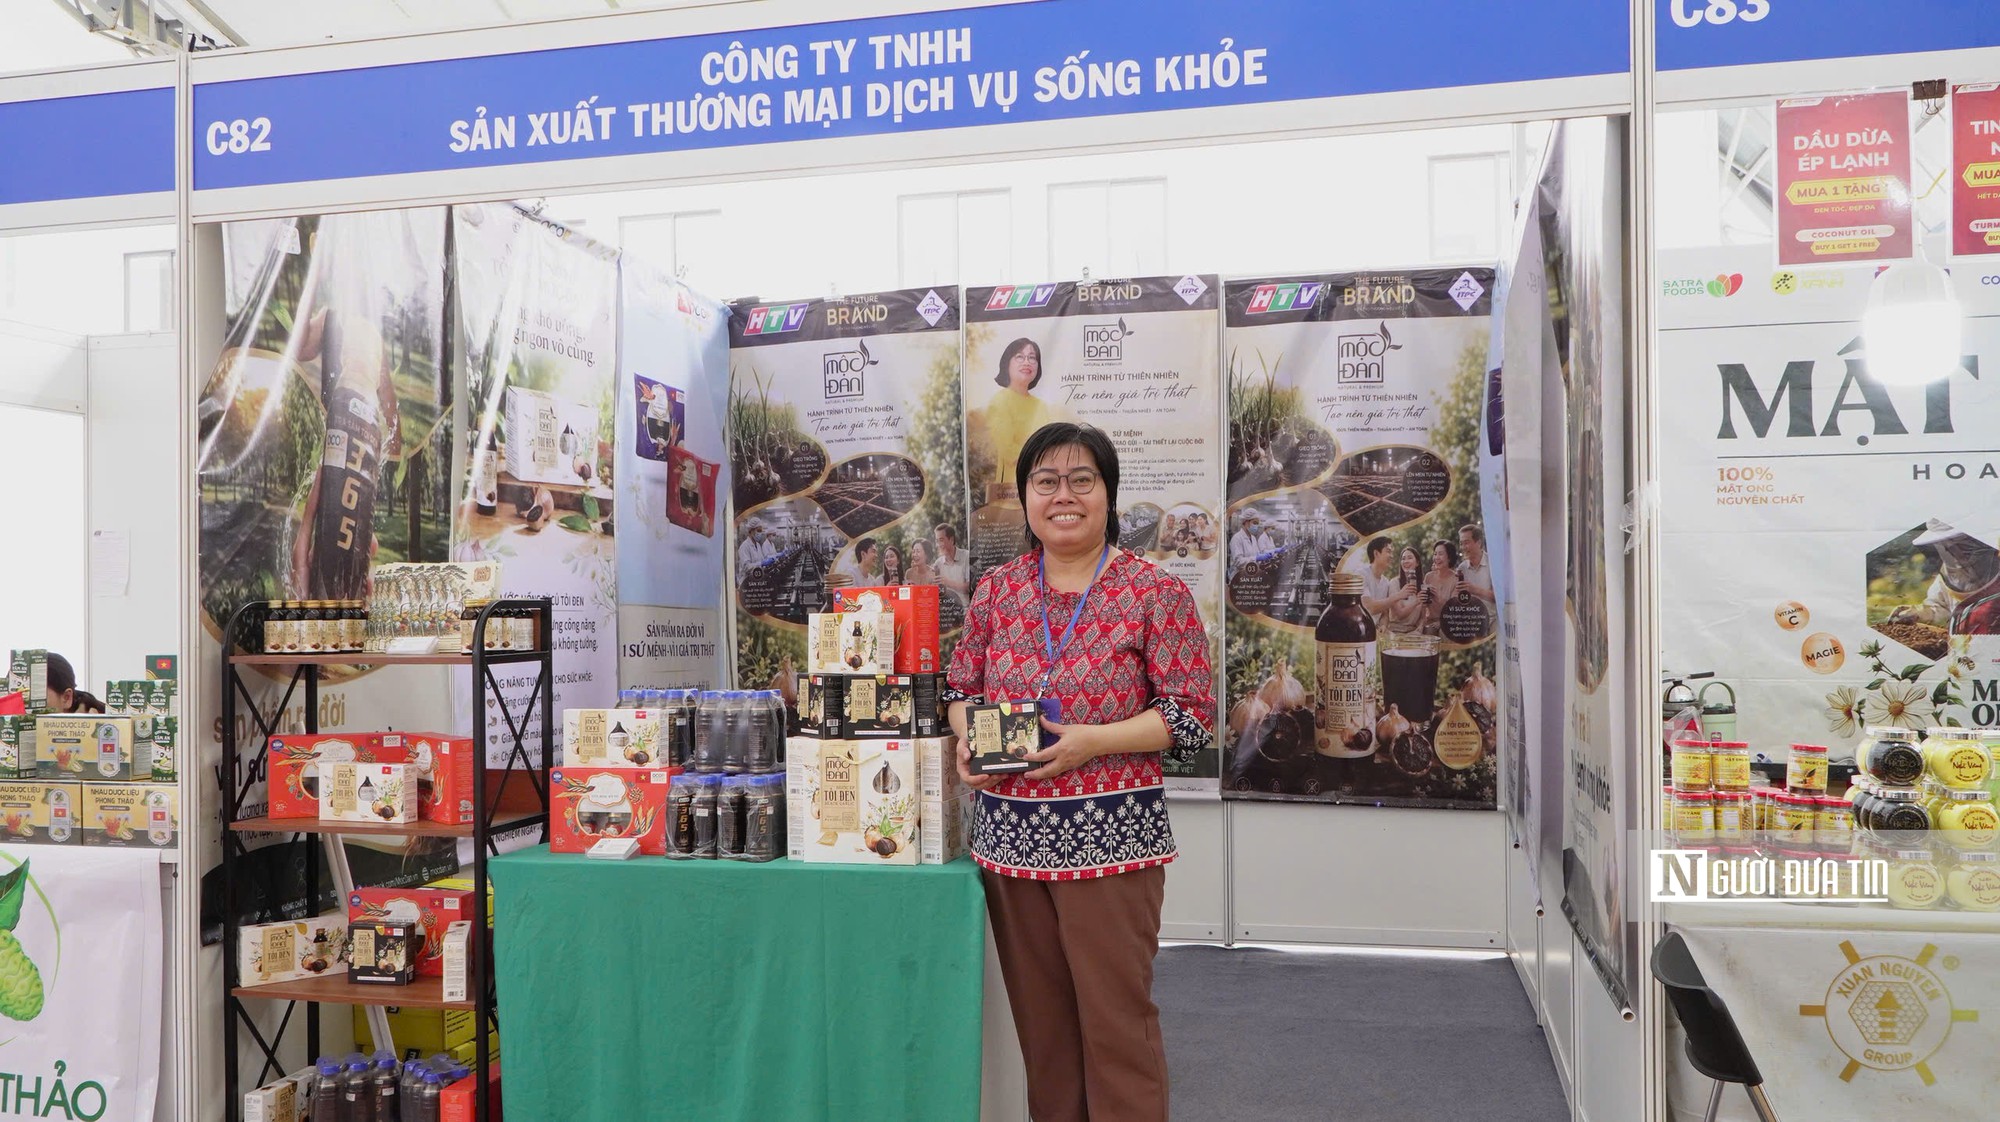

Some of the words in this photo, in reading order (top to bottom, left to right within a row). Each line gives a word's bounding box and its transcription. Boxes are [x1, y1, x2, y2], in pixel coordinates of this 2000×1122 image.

[700, 41, 799, 87] CÔNG
[808, 39, 858, 77] TY
[869, 27, 972, 71] TNHH
[449, 106, 516, 153] SẢN
[526, 96, 616, 146] XUẤT
[626, 92, 771, 138] THƯƠNG
[784, 86, 852, 128] MẠI
[866, 75, 954, 122] DỊCH
[968, 71, 1017, 113] VỤ
[1034, 51, 1141, 103] SỐNG
[1155, 37, 1268, 92] KHỎE
[206, 117, 271, 156] C82
[1794, 129, 1840, 151] DẦU
[1846, 128, 1893, 147] DỪA
[1798, 154, 1825, 172] ÉP
[1831, 152, 1889, 173] LẠNH
[1797, 188, 1828, 198] MUA
[1832, 187, 1839, 196] 1
[1844, 183, 1880, 197] TẶNG
[1811, 230, 1857, 238] COCONUT
[1252, 283, 1320, 308] HTV
[1372, 275, 1405, 284] FUTURE
[1663, 279, 1703, 289] SATRA
[1663, 286, 1705, 296] FOODS
[992, 284, 1050, 306] HTV
[1078, 285, 1142, 302] BRAND
[1344, 285, 1415, 306] BRAND
[749, 305, 804, 330] HTV
[826, 303, 888, 326] BRAND
[551, 338, 565, 355] vô
[1061, 374, 1085, 382] HÀNH
[1087, 373, 1112, 381] TRÌNH
[1114, 371, 1126, 381] TỪ
[1128, 371, 1151, 380] THIÊN
[1153, 370, 1179, 379] NHIÊN
[1091, 389, 1115, 400] nên
[1114, 390, 1139, 408] giá
[1143, 384, 1160, 400] trị
[1163, 382, 1199, 400] thật
[1373, 393, 1394, 401] THIÊN
[1395, 392, 1418, 401] NHIÊN
[1364, 410, 1384, 426] giá
[1401, 404, 1430, 419] thật
[1112, 429, 1122, 437] SỨ
[1123, 429, 1143, 437] MỆNH
[1717, 467, 1774, 482] 100%
[1746, 484, 1774, 493] ONG
[1717, 495, 1768, 505] NGUYÊN
[1772, 493, 1805, 504] CHẤT
[1777, 606, 1804, 618] VITAMIN
[1788, 615, 1799, 626] C
[564, 618, 580, 633] công
[580, 618, 596, 633] năng
[646, 620, 661, 637] SẢN
[661, 619, 676, 638] PHẨM
[677, 625, 685, 638] RA
[686, 623, 697, 638] ĐỜI
[698, 622, 704, 638] VÌ
[558, 636, 579, 653] không
[623, 644, 627, 657] 1
[629, 641, 646, 657] SỨ
[690, 644, 699, 659] TRỊ
[701, 641, 715, 659] THẬT
[1806, 646, 1841, 663] MAGIE
[506, 676, 525, 689] NĂNG
[554, 675, 565, 684] CHO
[567, 671, 578, 683] SỨC
[1329, 687, 1343, 701] TỎI
[319, 693, 345, 728] đời
[824, 787, 838, 801] TỎI
[840, 790, 855, 801] ĐEN
[1836, 964, 1875, 999] XUAN
[1880, 962, 1941, 1001] NGUYEN
[1863, 1049, 1914, 1065] GROUP
[0, 1060, 107, 1122] THẢO
